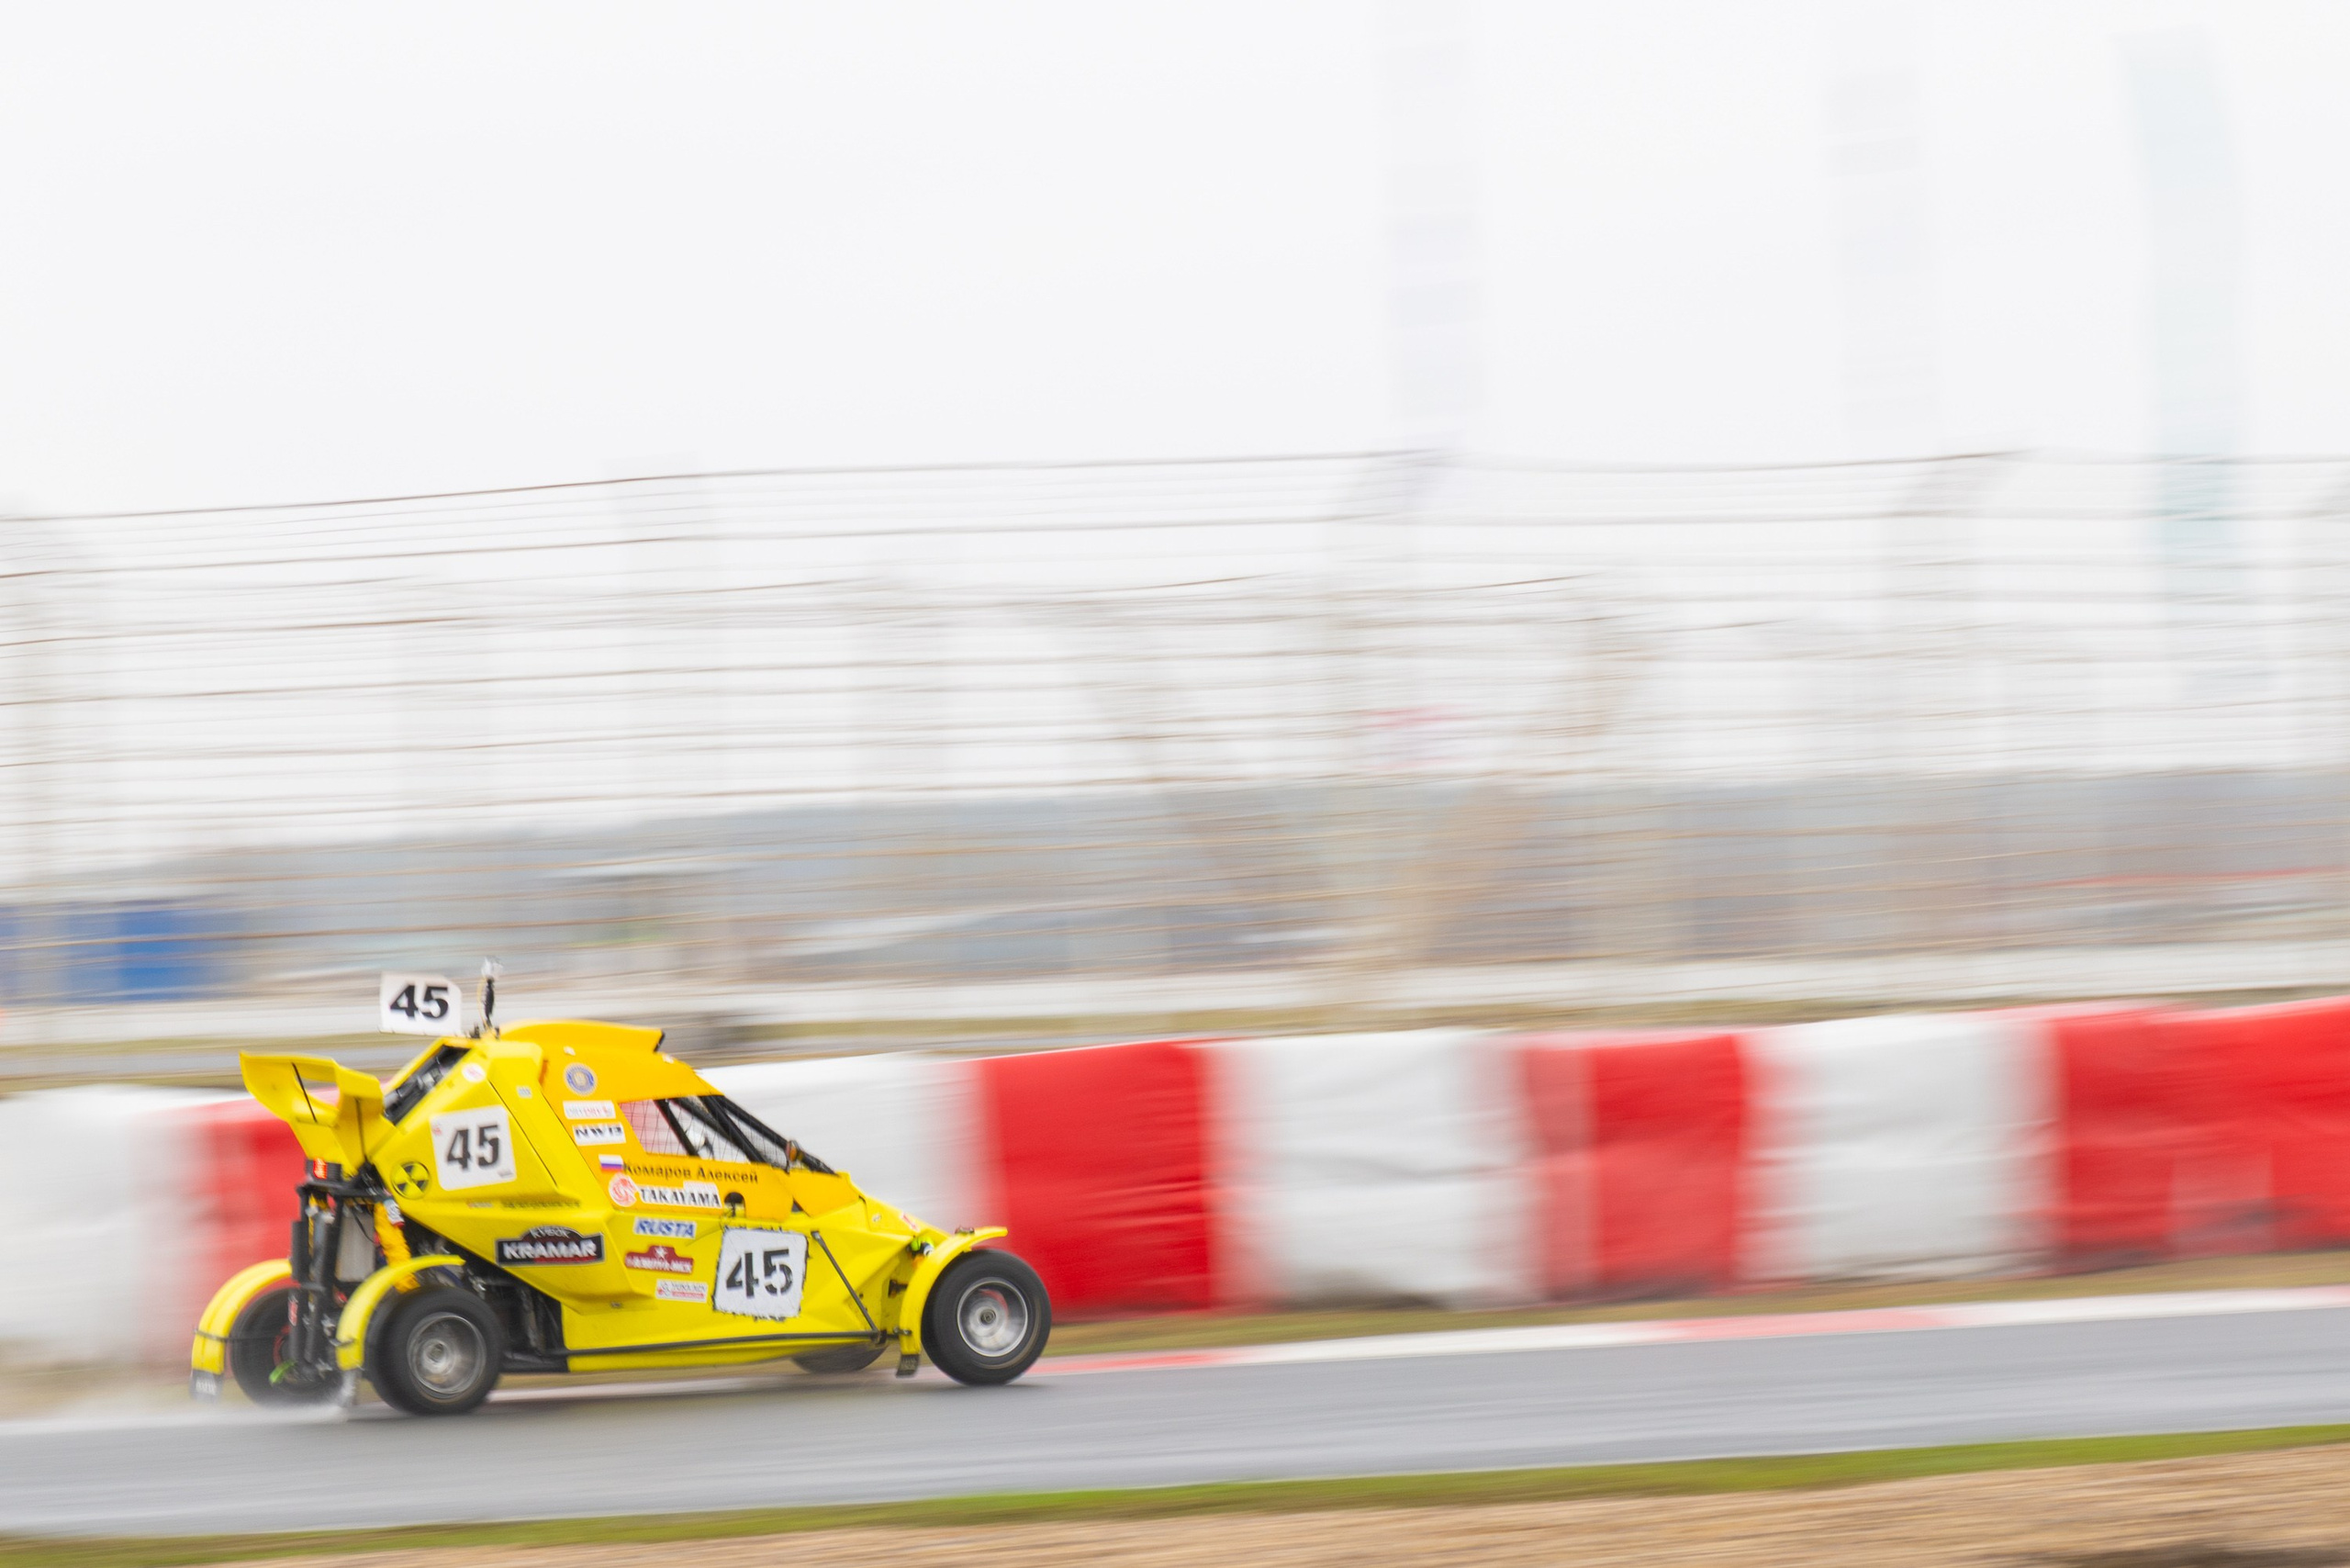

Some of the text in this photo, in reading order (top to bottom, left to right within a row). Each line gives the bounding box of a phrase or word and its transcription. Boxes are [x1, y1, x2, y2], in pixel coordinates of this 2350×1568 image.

[389, 983, 450, 1021] 45
[446, 1123, 500, 1171] 45
[624, 1161, 758, 1184] Комаров Алексей
[641, 1189, 721, 1208] TAKAYAMA
[502, 1239, 598, 1260] KRAMAR
[724, 1248, 794, 1299] 45
